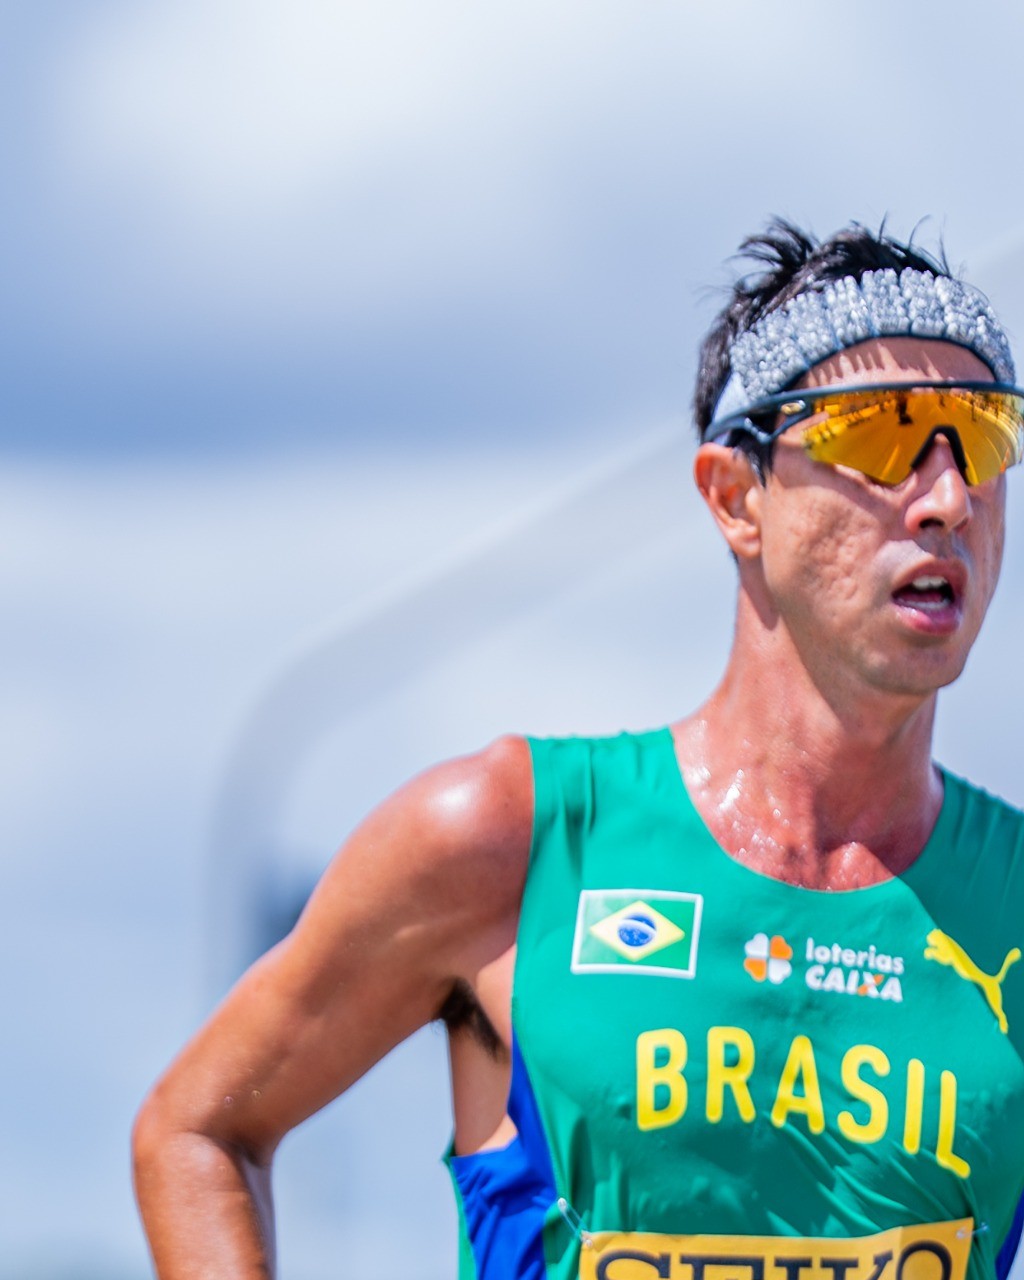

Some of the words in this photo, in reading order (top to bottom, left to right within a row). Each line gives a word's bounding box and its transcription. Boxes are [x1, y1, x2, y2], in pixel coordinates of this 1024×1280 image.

[806, 937, 904, 974] loterias
[805, 970, 903, 1002] CAIXA
[636, 1026, 971, 1178] BRASIL
